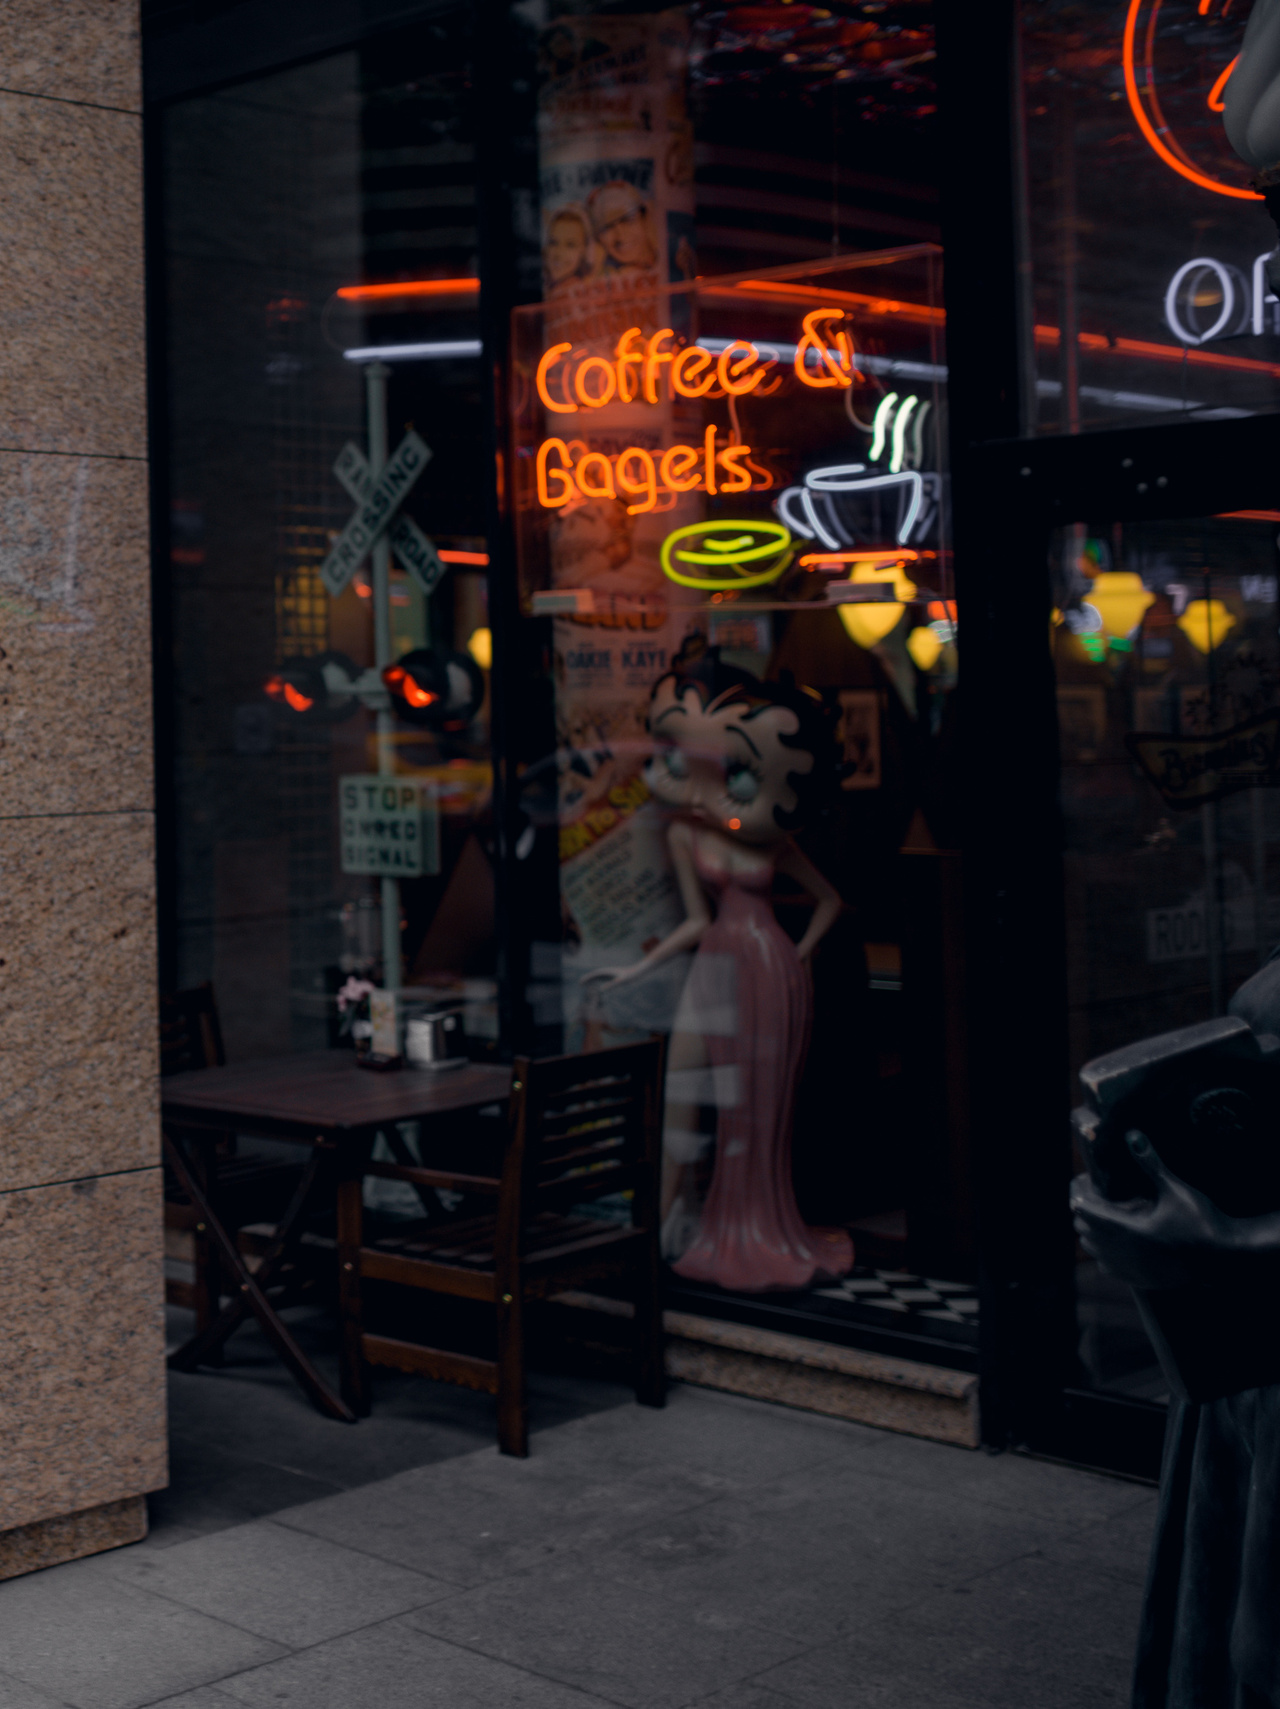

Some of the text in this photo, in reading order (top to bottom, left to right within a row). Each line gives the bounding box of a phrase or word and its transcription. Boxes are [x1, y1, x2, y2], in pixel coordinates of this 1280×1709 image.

[536, 308, 852, 413] Coffee &
[327, 446, 419, 584] CROSSING
[536, 423, 752, 516] Bagels
[343, 785, 416, 813] STOP
[345, 845, 417, 869] SIGNAL
